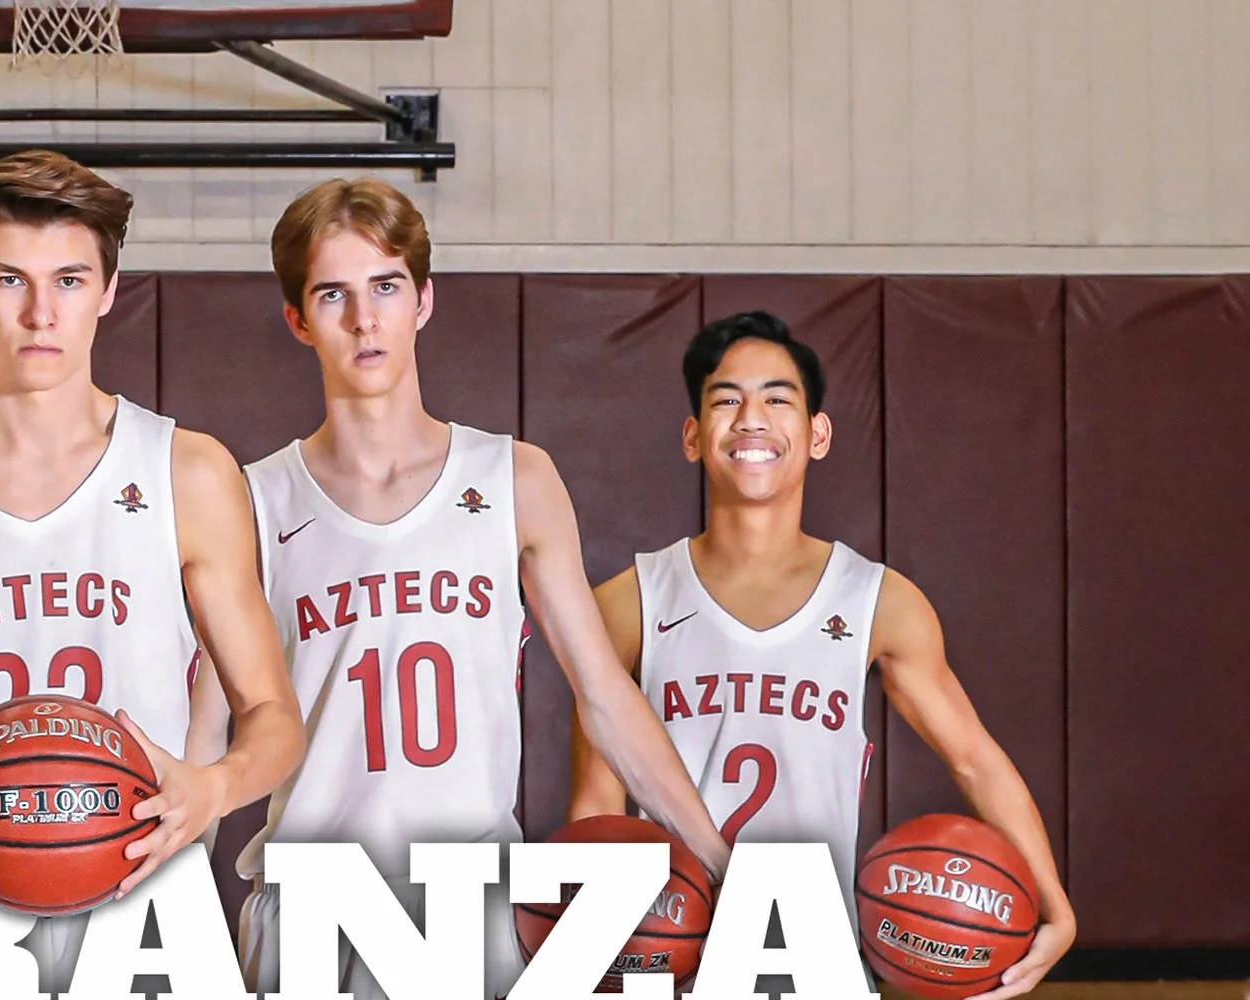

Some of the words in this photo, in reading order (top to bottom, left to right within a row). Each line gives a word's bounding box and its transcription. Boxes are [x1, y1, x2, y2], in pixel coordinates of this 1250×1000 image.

[295, 569, 494, 642] AZTECS
[347, 640, 458, 773] 10
[663, 672, 849, 732] AZTECS
[719, 742, 778, 850] 2
[883, 863, 1014, 924] SPALDING
[878, 918, 968, 960] PLATINUM
[969, 945, 994, 962] ZK
